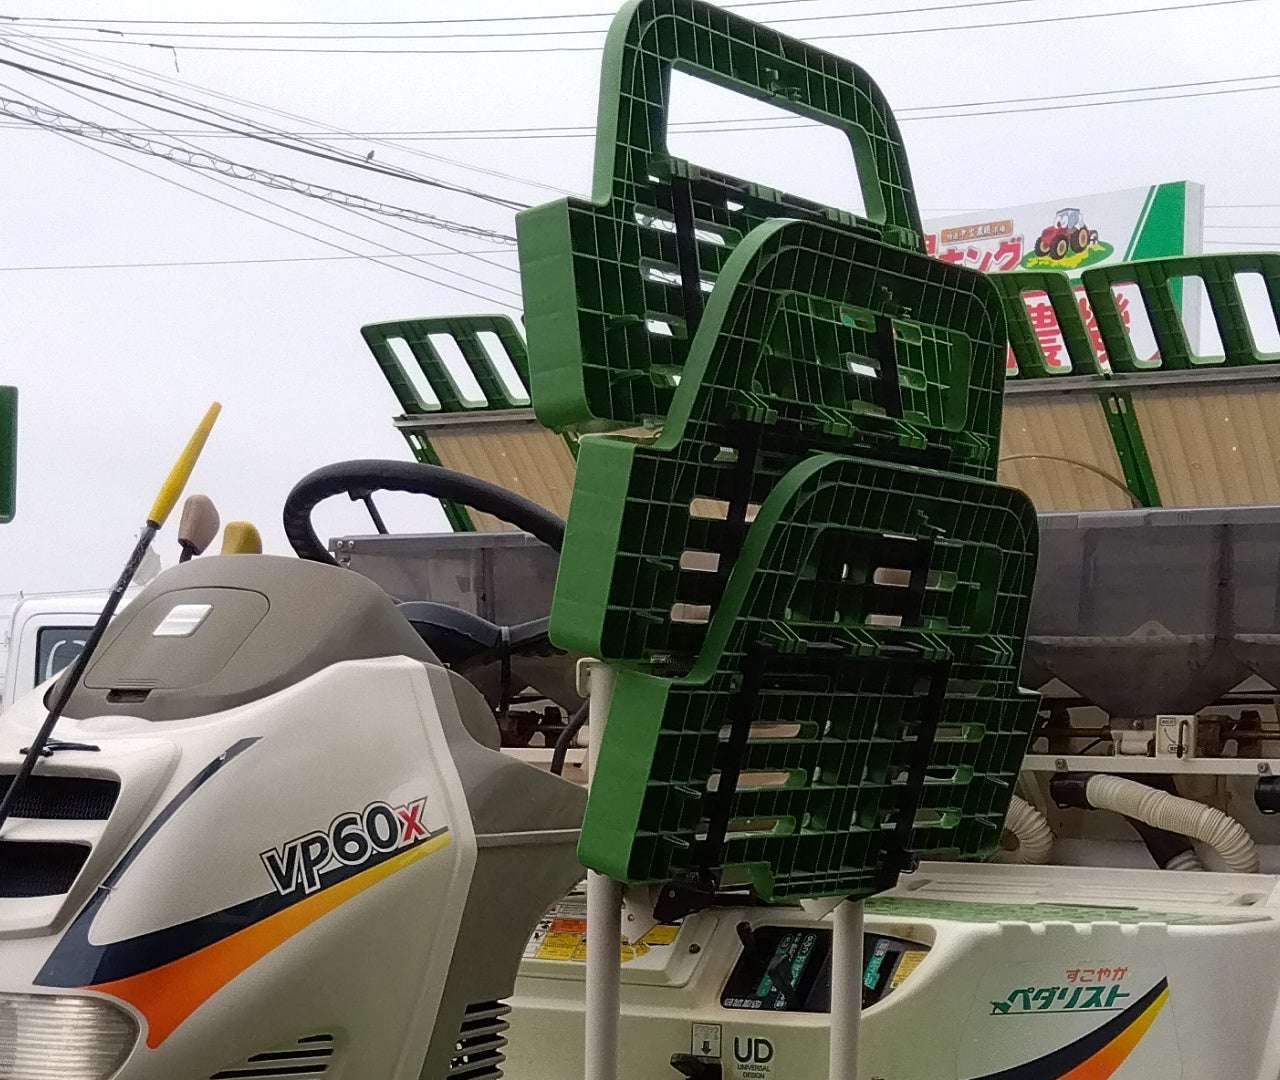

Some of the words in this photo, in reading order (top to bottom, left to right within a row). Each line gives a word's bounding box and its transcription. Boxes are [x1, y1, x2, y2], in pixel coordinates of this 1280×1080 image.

[1008, 984, 1130, 1010] ペダリスト
[734, 1036, 774, 1064] UD
[737, 1064, 771, 1072] UNIVERSAL
[742, 1071, 765, 1079] DESIGN
